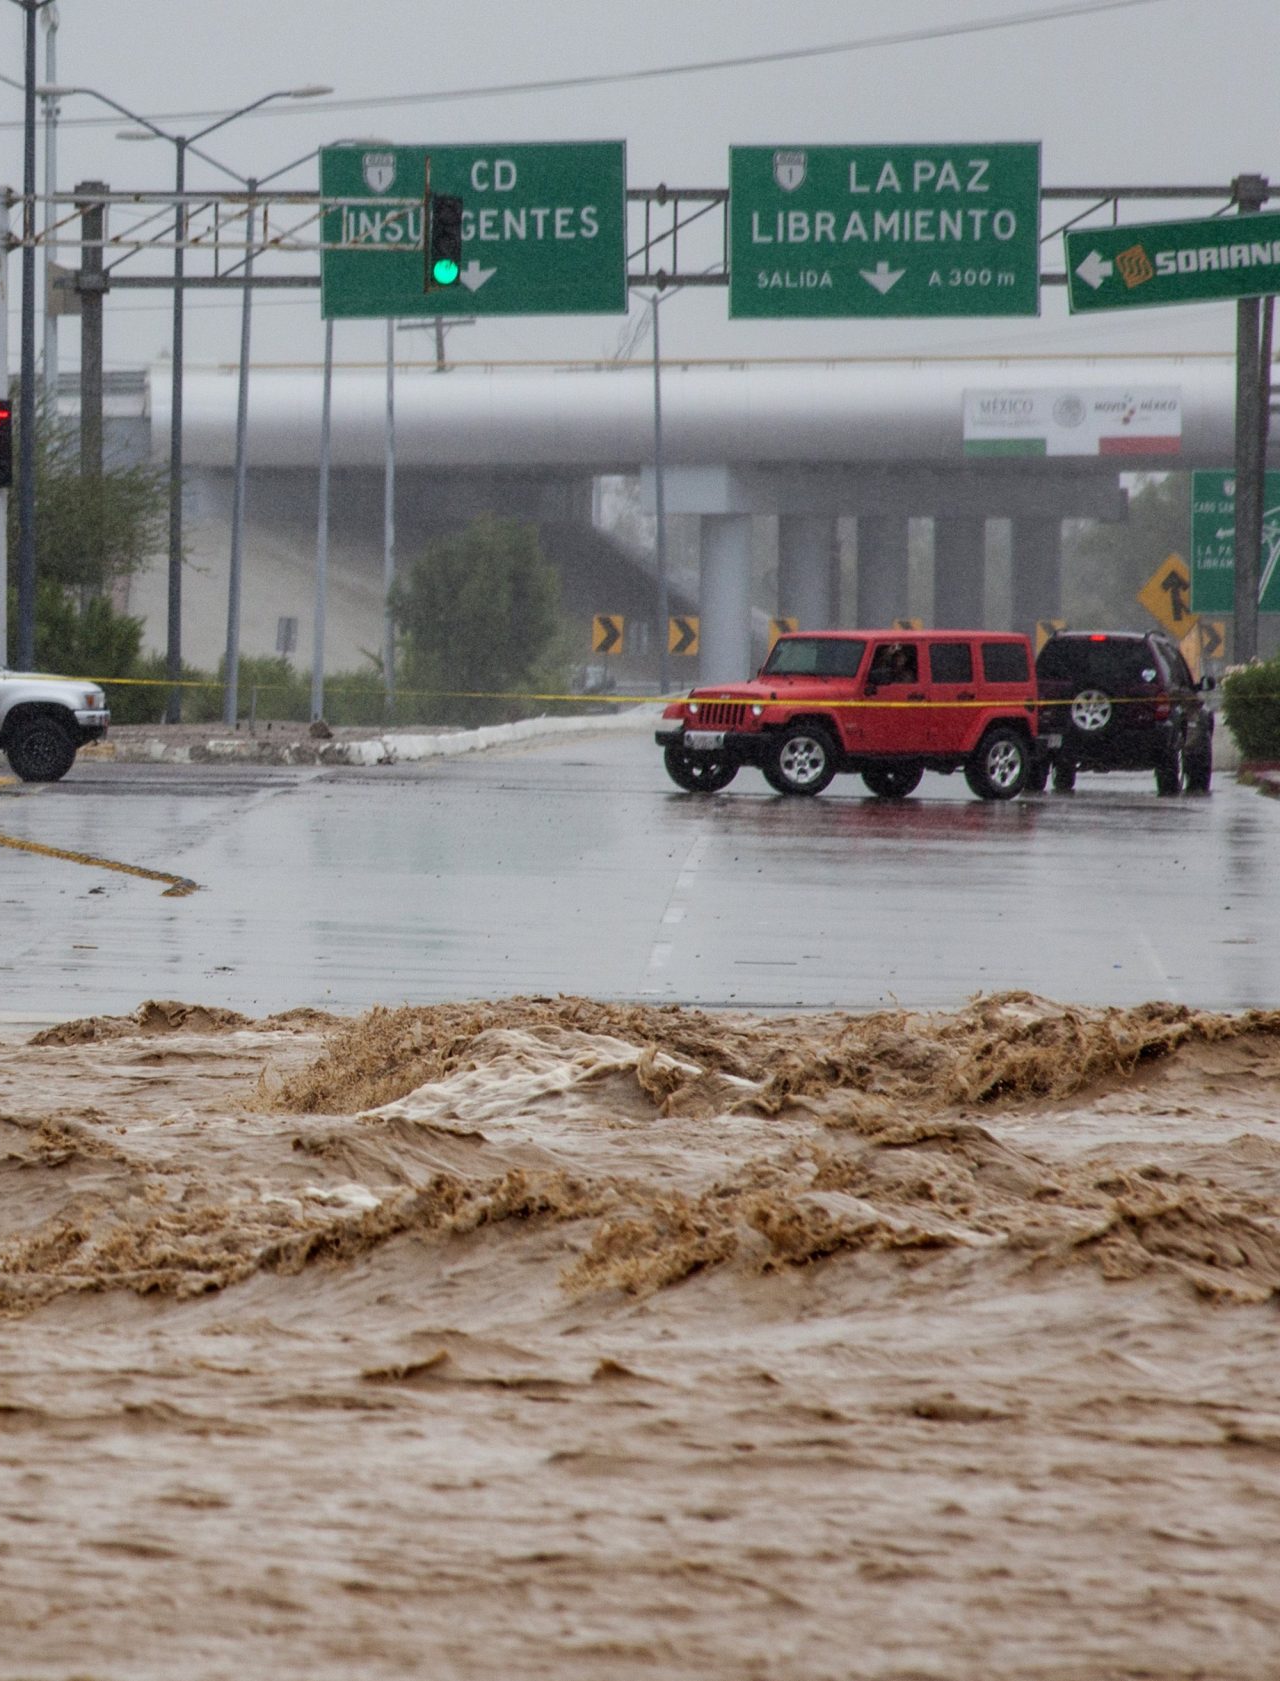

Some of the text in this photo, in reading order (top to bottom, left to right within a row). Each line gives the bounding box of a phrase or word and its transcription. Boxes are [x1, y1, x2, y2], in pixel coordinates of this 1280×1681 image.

[471, 160, 517, 192] CD
[849, 160, 990, 193] LA PAZ
[348, 204, 599, 242] INSUGENTES
[752, 209, 1017, 243] LIBRAMIENTO
[757, 270, 833, 288] SALIDA
[928, 270, 942, 287] A
[948, 268, 992, 286] 300
